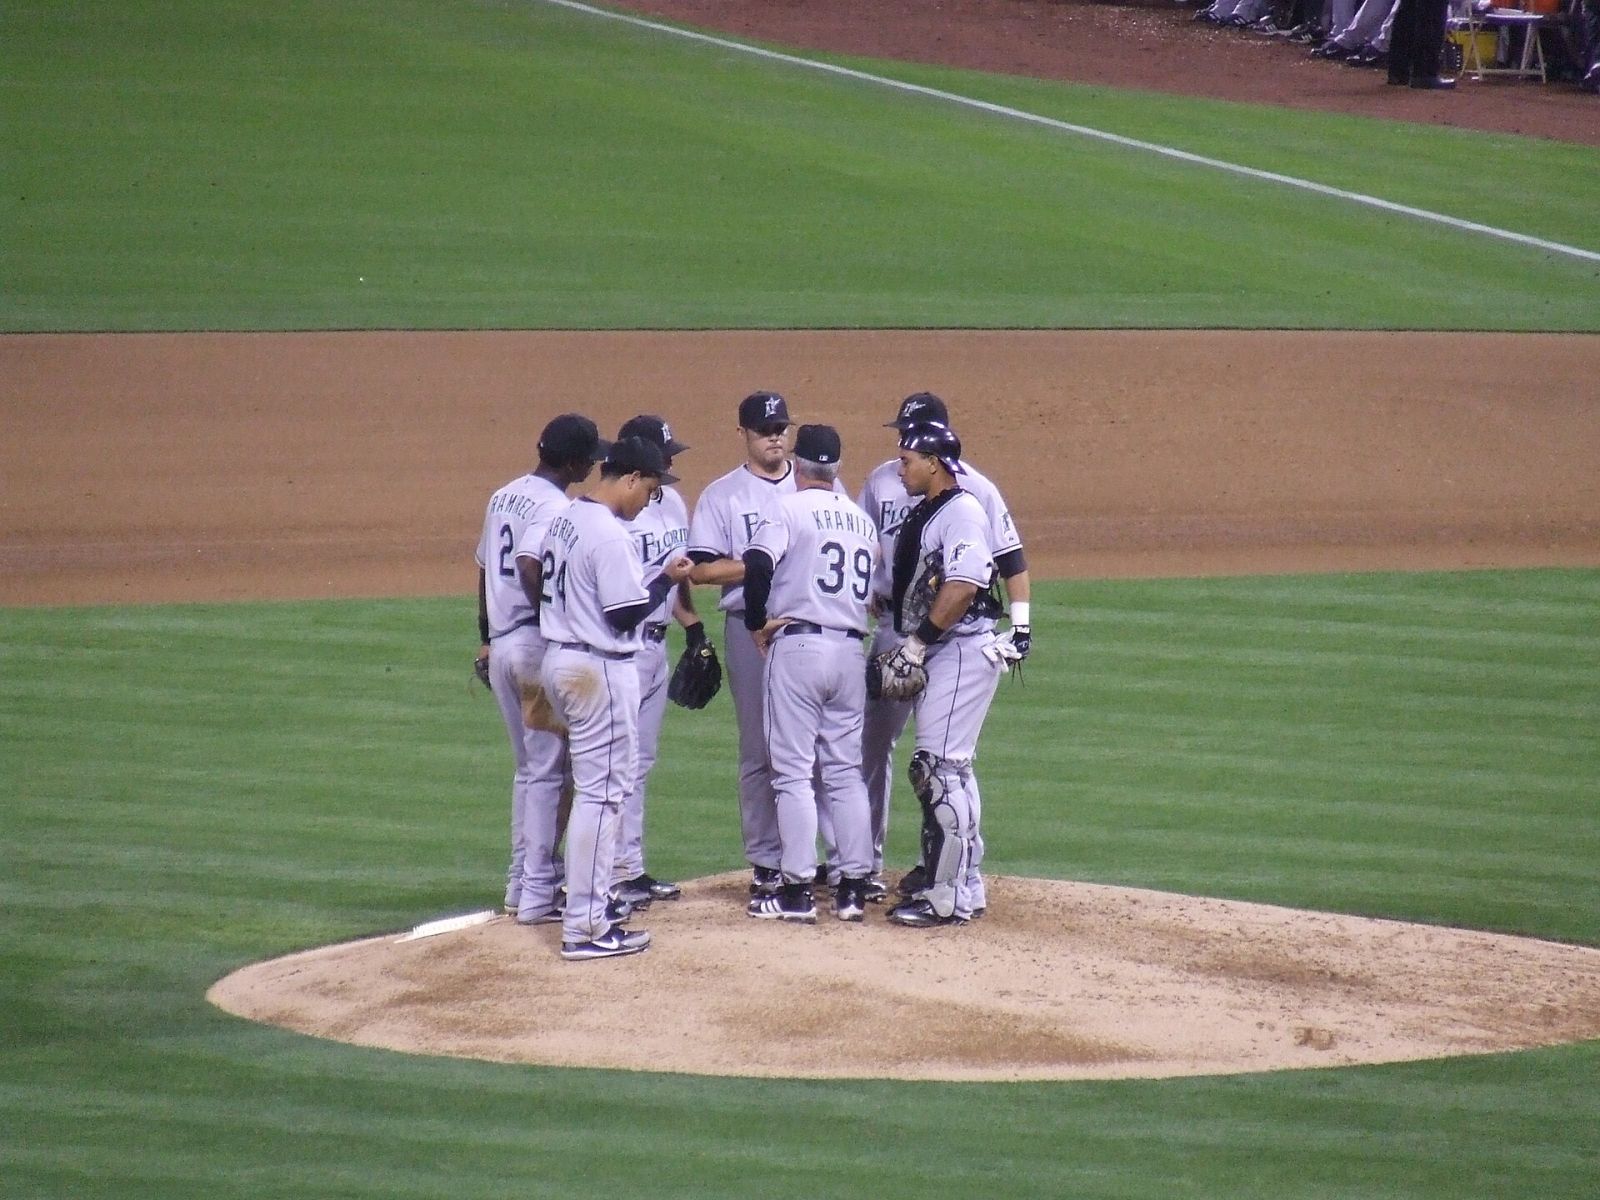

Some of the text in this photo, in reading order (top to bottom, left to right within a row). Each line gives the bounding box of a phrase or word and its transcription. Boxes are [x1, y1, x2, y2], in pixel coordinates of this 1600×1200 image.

[499, 523, 515, 577] 2
[640, 528, 688, 563] FLORID
[812, 509, 875, 542] KRANITZ
[540, 549, 567, 613] 24
[816, 541, 872, 601] 39
